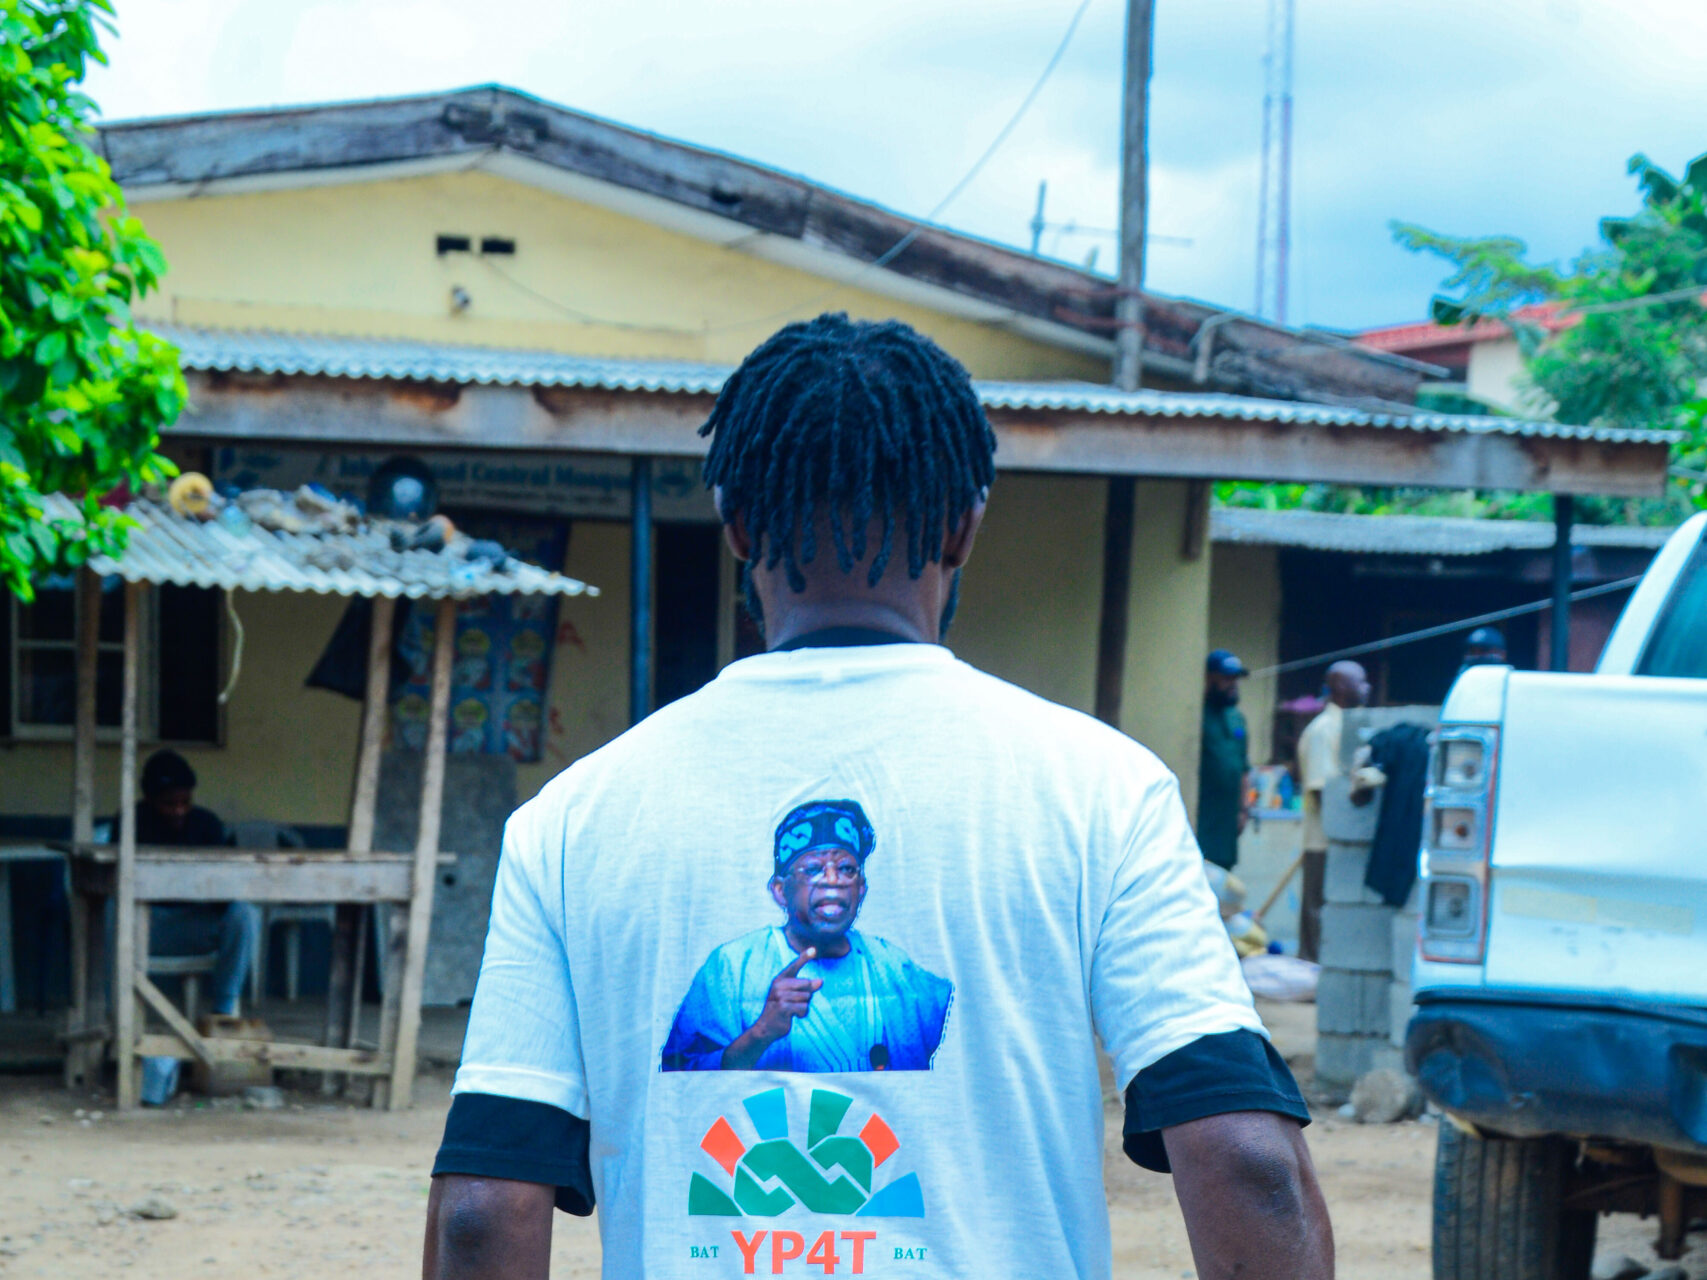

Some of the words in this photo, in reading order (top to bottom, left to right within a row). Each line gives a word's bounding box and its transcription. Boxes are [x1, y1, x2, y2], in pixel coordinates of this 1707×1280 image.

[689, 1246, 719, 1259] BAT
[730, 1230, 877, 1275] YP4T
[893, 1247, 928, 1261] BAT
